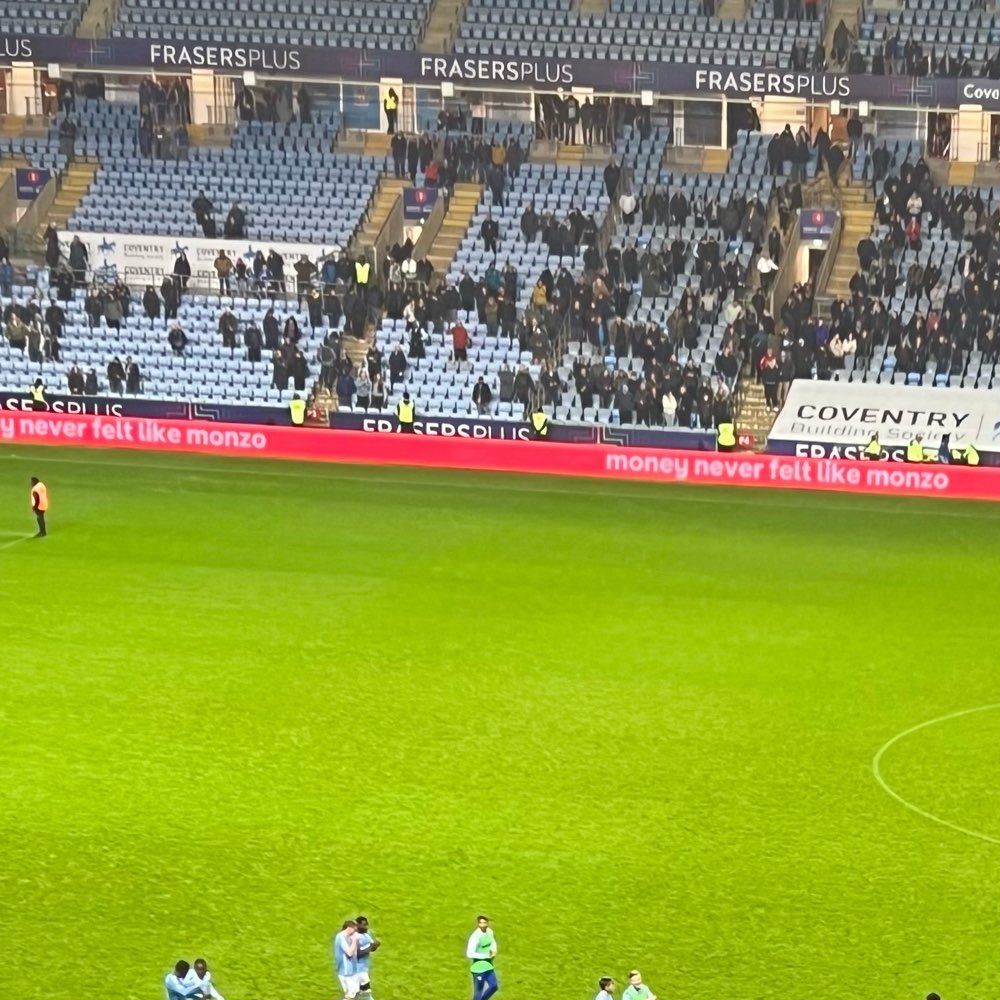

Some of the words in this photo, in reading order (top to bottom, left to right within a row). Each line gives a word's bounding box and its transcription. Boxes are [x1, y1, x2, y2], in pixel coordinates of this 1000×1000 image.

[0, 38, 32, 57] US
[150, 44, 301, 70] FRASERSPLUS
[421, 57, 573, 84] FRASERSPLUS
[695, 70, 851, 97] FRASERSPLUS
[797, 404, 970, 428] COVENTRY
[20, 418, 87, 438] never
[93, 417, 135, 441] felt
[138, 418, 181, 444] like
[186, 428, 267, 449] monzo
[606, 454, 689, 480] money
[694, 458, 764, 479] never
[769, 459, 812, 482] felt
[817, 460, 861, 484] like
[866, 467, 949, 489] monzo
